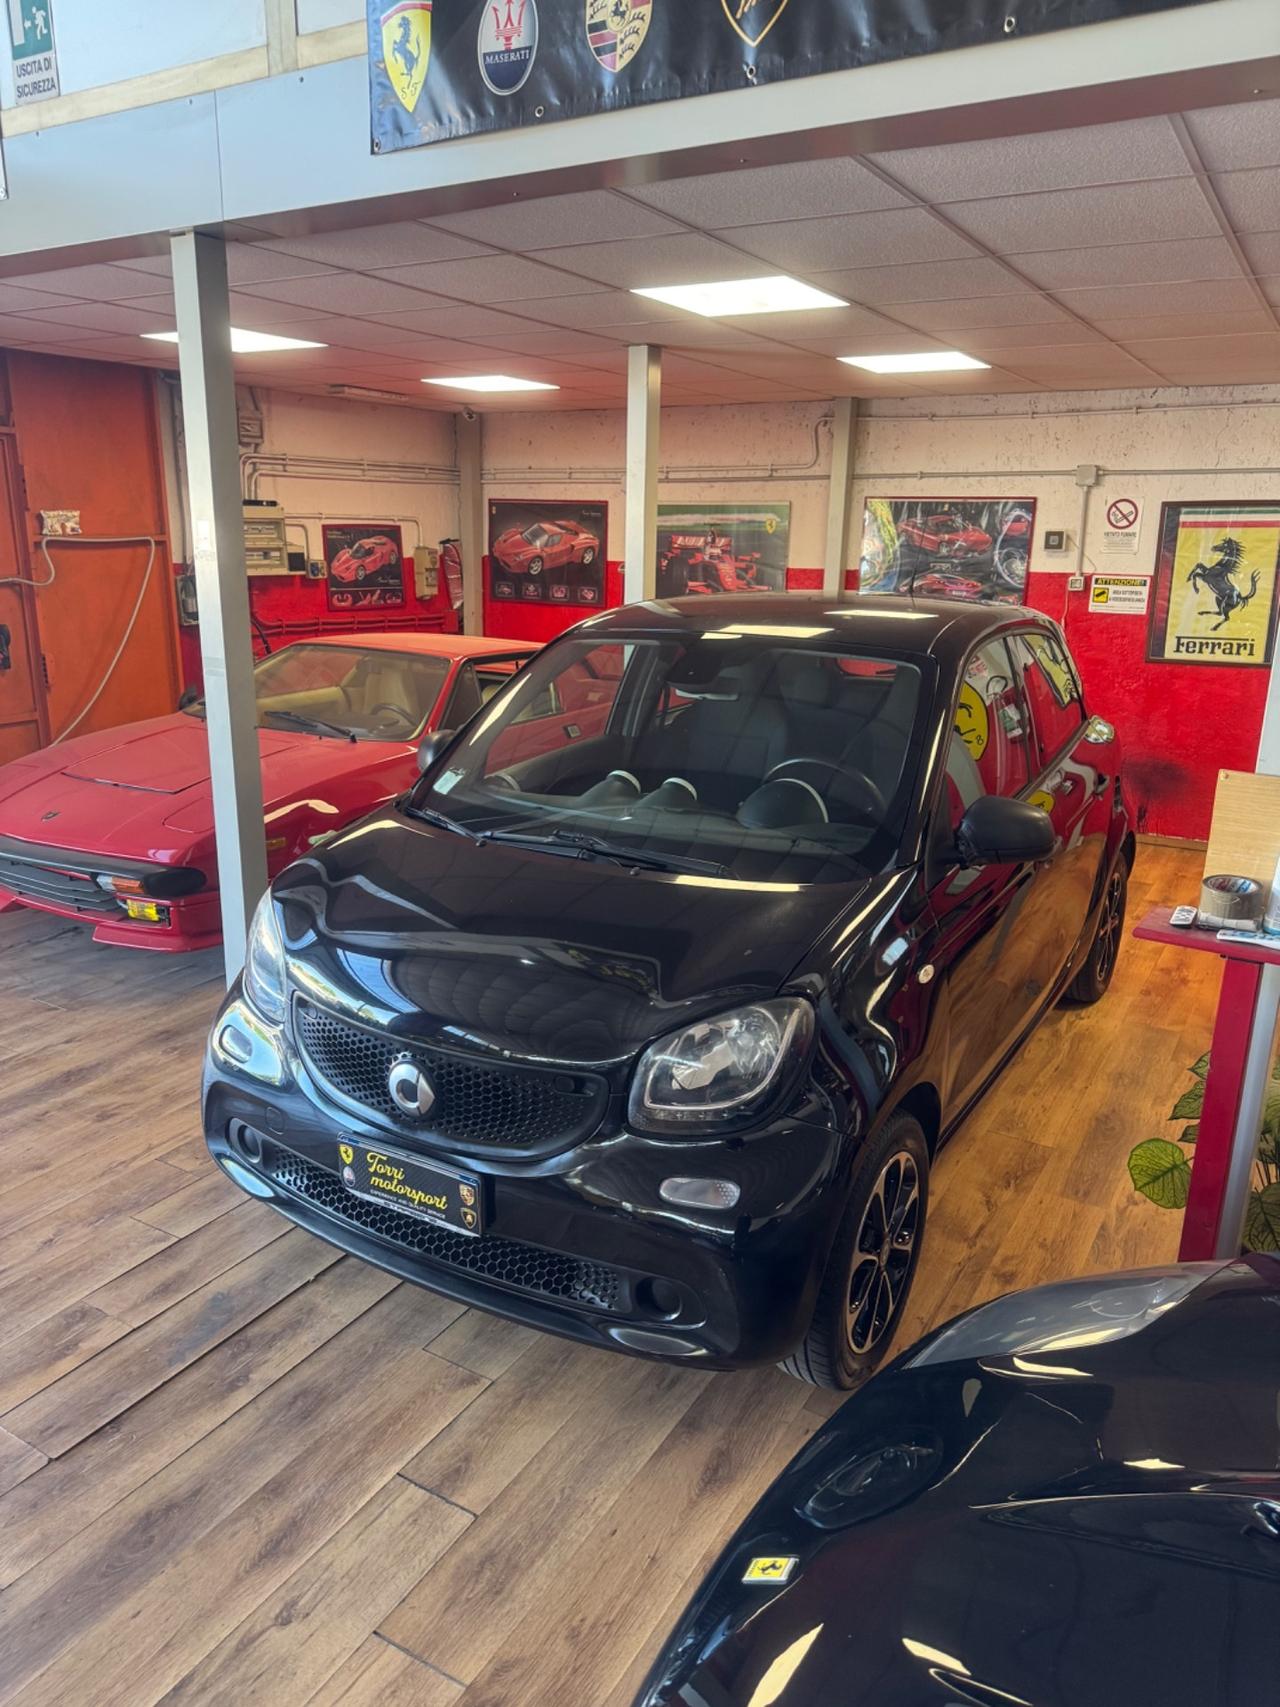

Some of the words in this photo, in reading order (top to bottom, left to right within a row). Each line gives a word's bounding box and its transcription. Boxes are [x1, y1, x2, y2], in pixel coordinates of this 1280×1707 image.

[16, 60, 43, 78] USCITA
[44, 56, 52, 71] DI
[485, 50, 530, 64] MASERATI
[16, 77, 56, 98] SICUREZZA
[1173, 636, 1255, 656] Ferrari
[367, 1152, 405, 1180] Torri
[370, 1176, 448, 1210] motorsport
